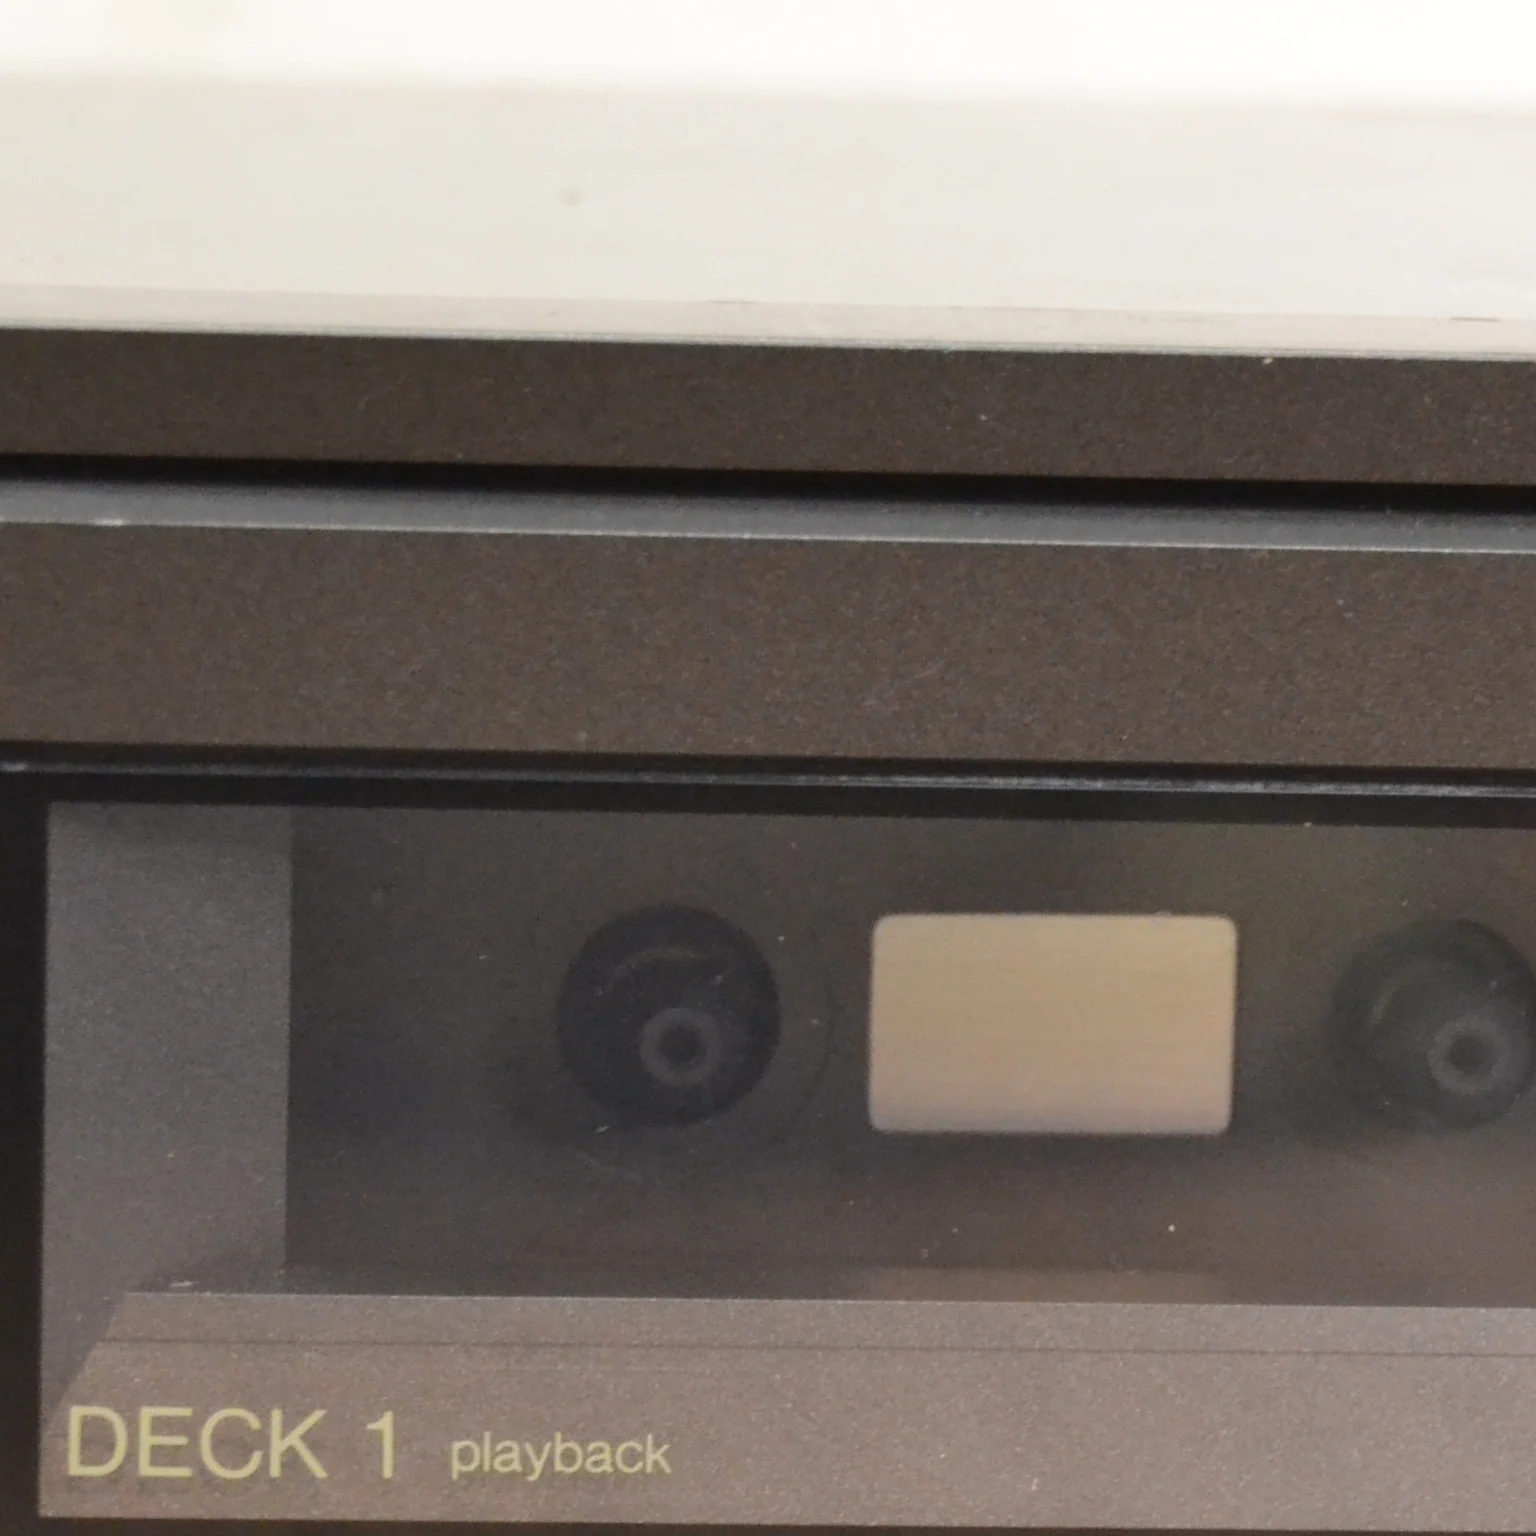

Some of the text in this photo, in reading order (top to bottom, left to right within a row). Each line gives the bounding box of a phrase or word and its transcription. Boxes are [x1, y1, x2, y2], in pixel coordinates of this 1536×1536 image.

[66, 1404, 672, 1483] DECK 1 playback
